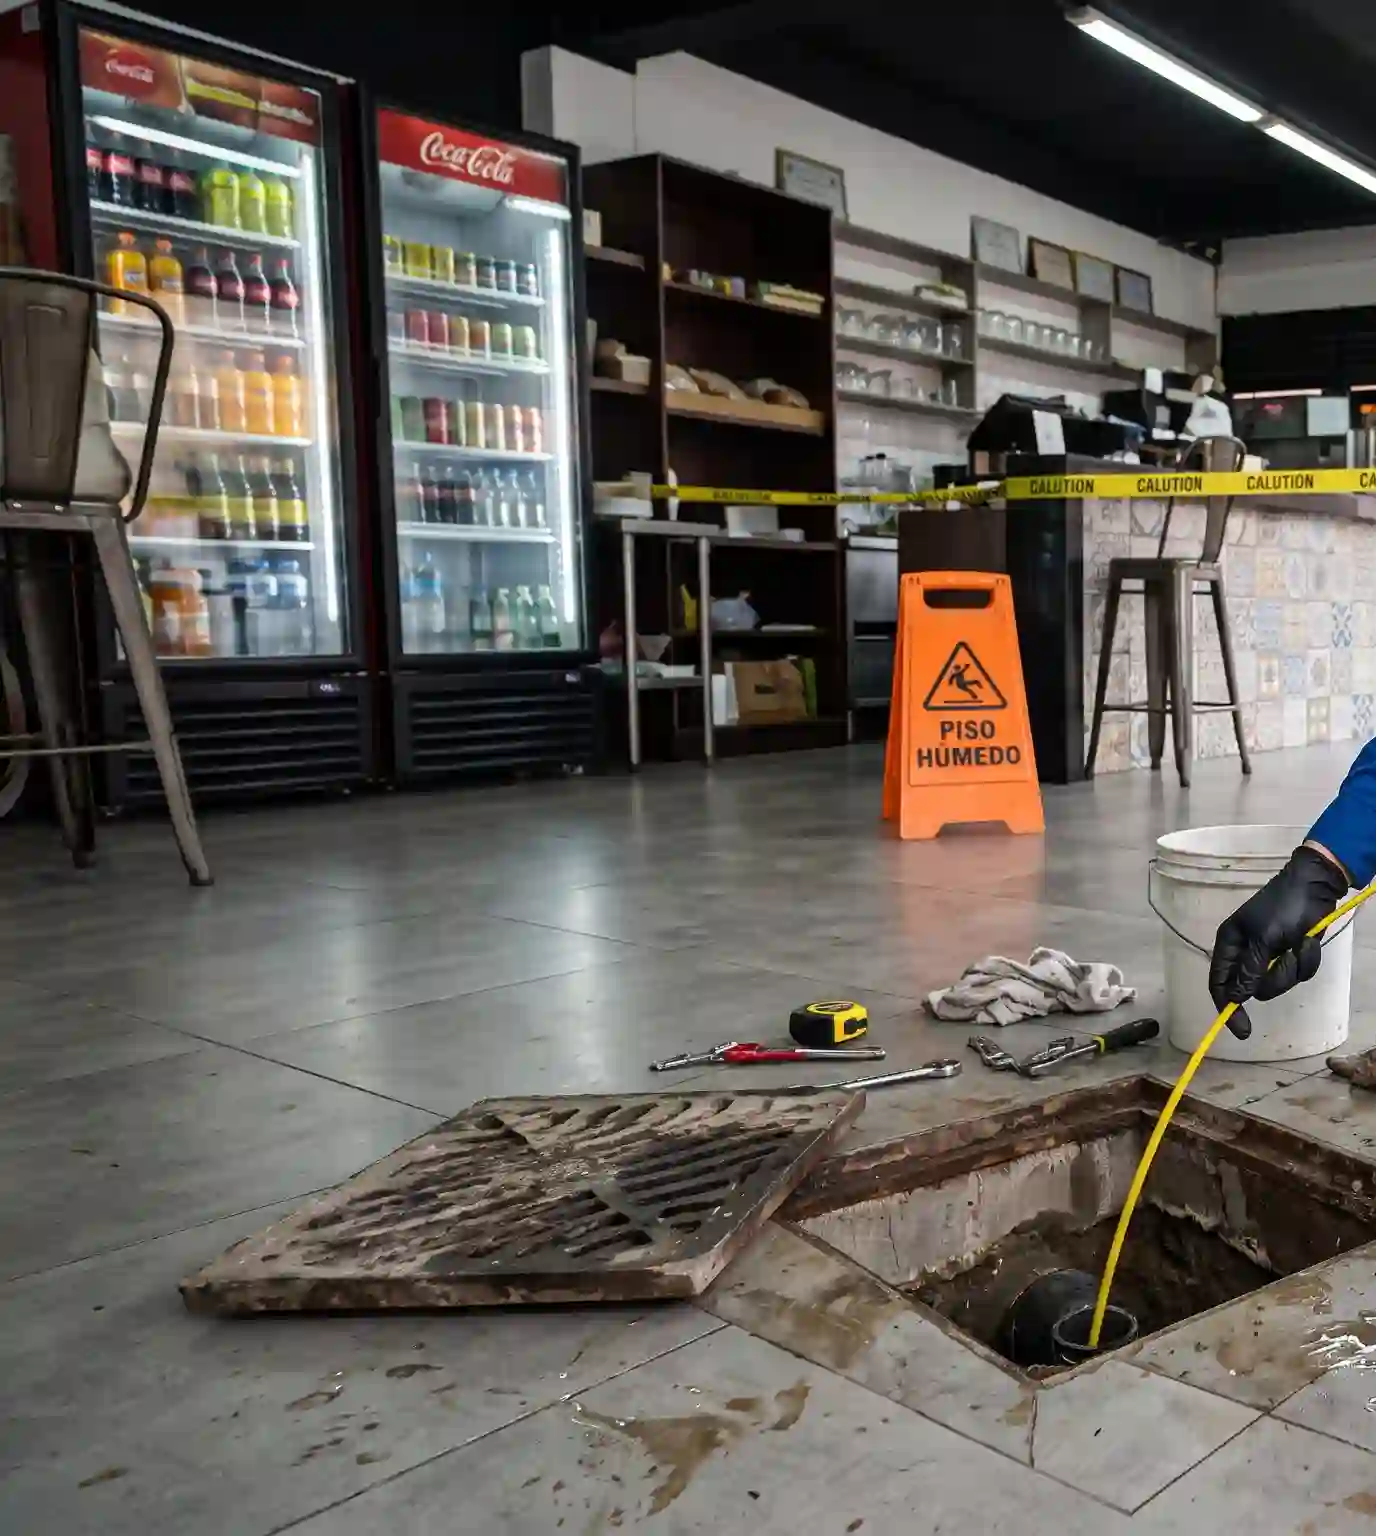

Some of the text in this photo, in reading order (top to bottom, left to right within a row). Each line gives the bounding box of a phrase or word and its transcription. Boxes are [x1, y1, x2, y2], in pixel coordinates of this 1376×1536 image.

[420, 132, 516, 184] Coca-Cola
[1137, 477, 1202, 493] CALUTION
[1247, 475, 1314, 490] CALUTION
[940, 720, 995, 740] PISO
